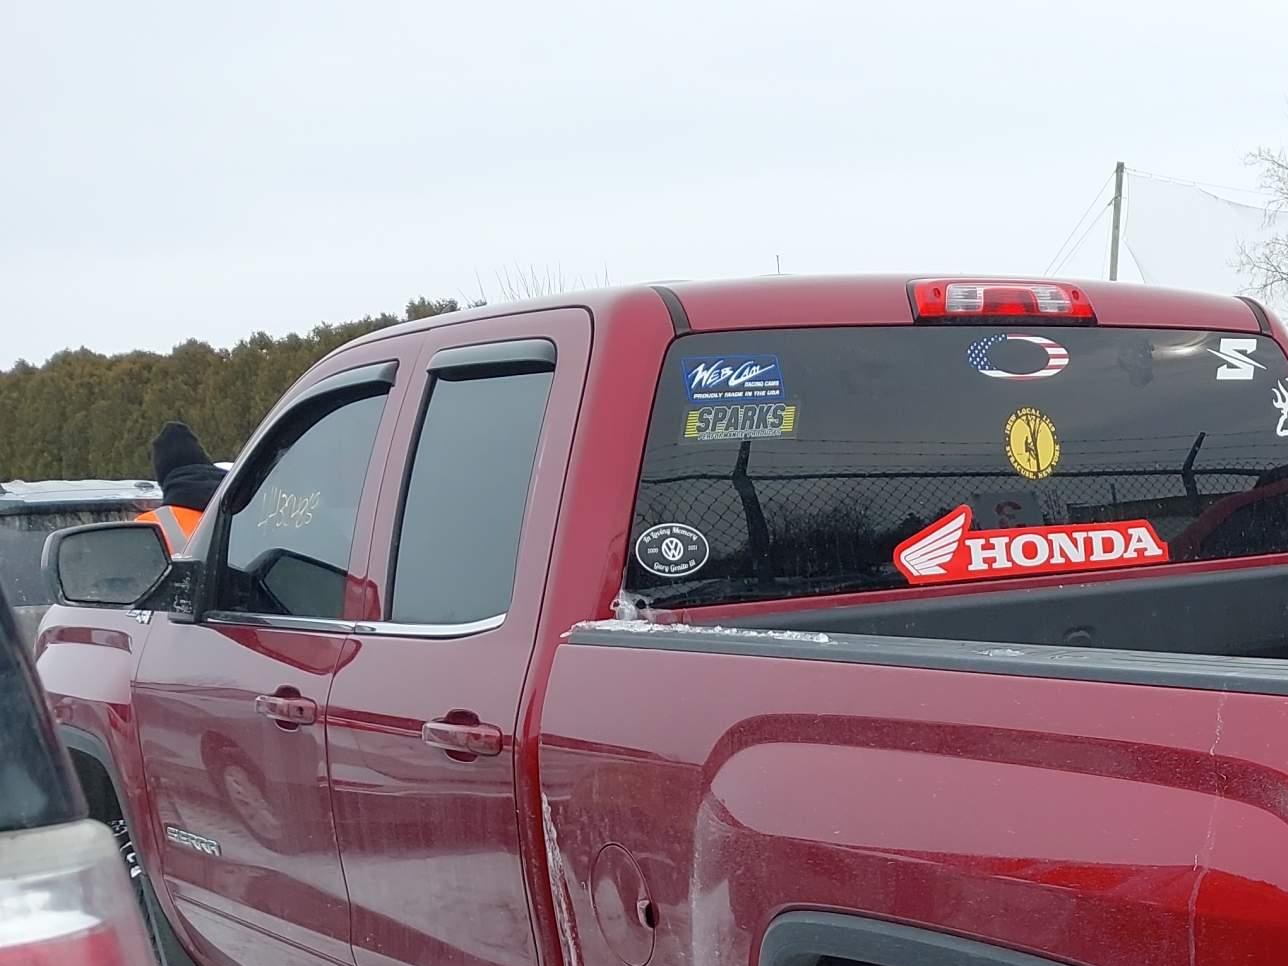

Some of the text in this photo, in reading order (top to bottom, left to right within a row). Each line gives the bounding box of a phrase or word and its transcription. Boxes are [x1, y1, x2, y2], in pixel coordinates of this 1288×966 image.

[696, 403, 787, 434] SPARKS
[1017, 408, 1041, 416] LOCAL
[672, 526, 699, 541] Memory
[965, 527, 1163, 571] HONDA
[166, 826, 221, 856] SIERRA
